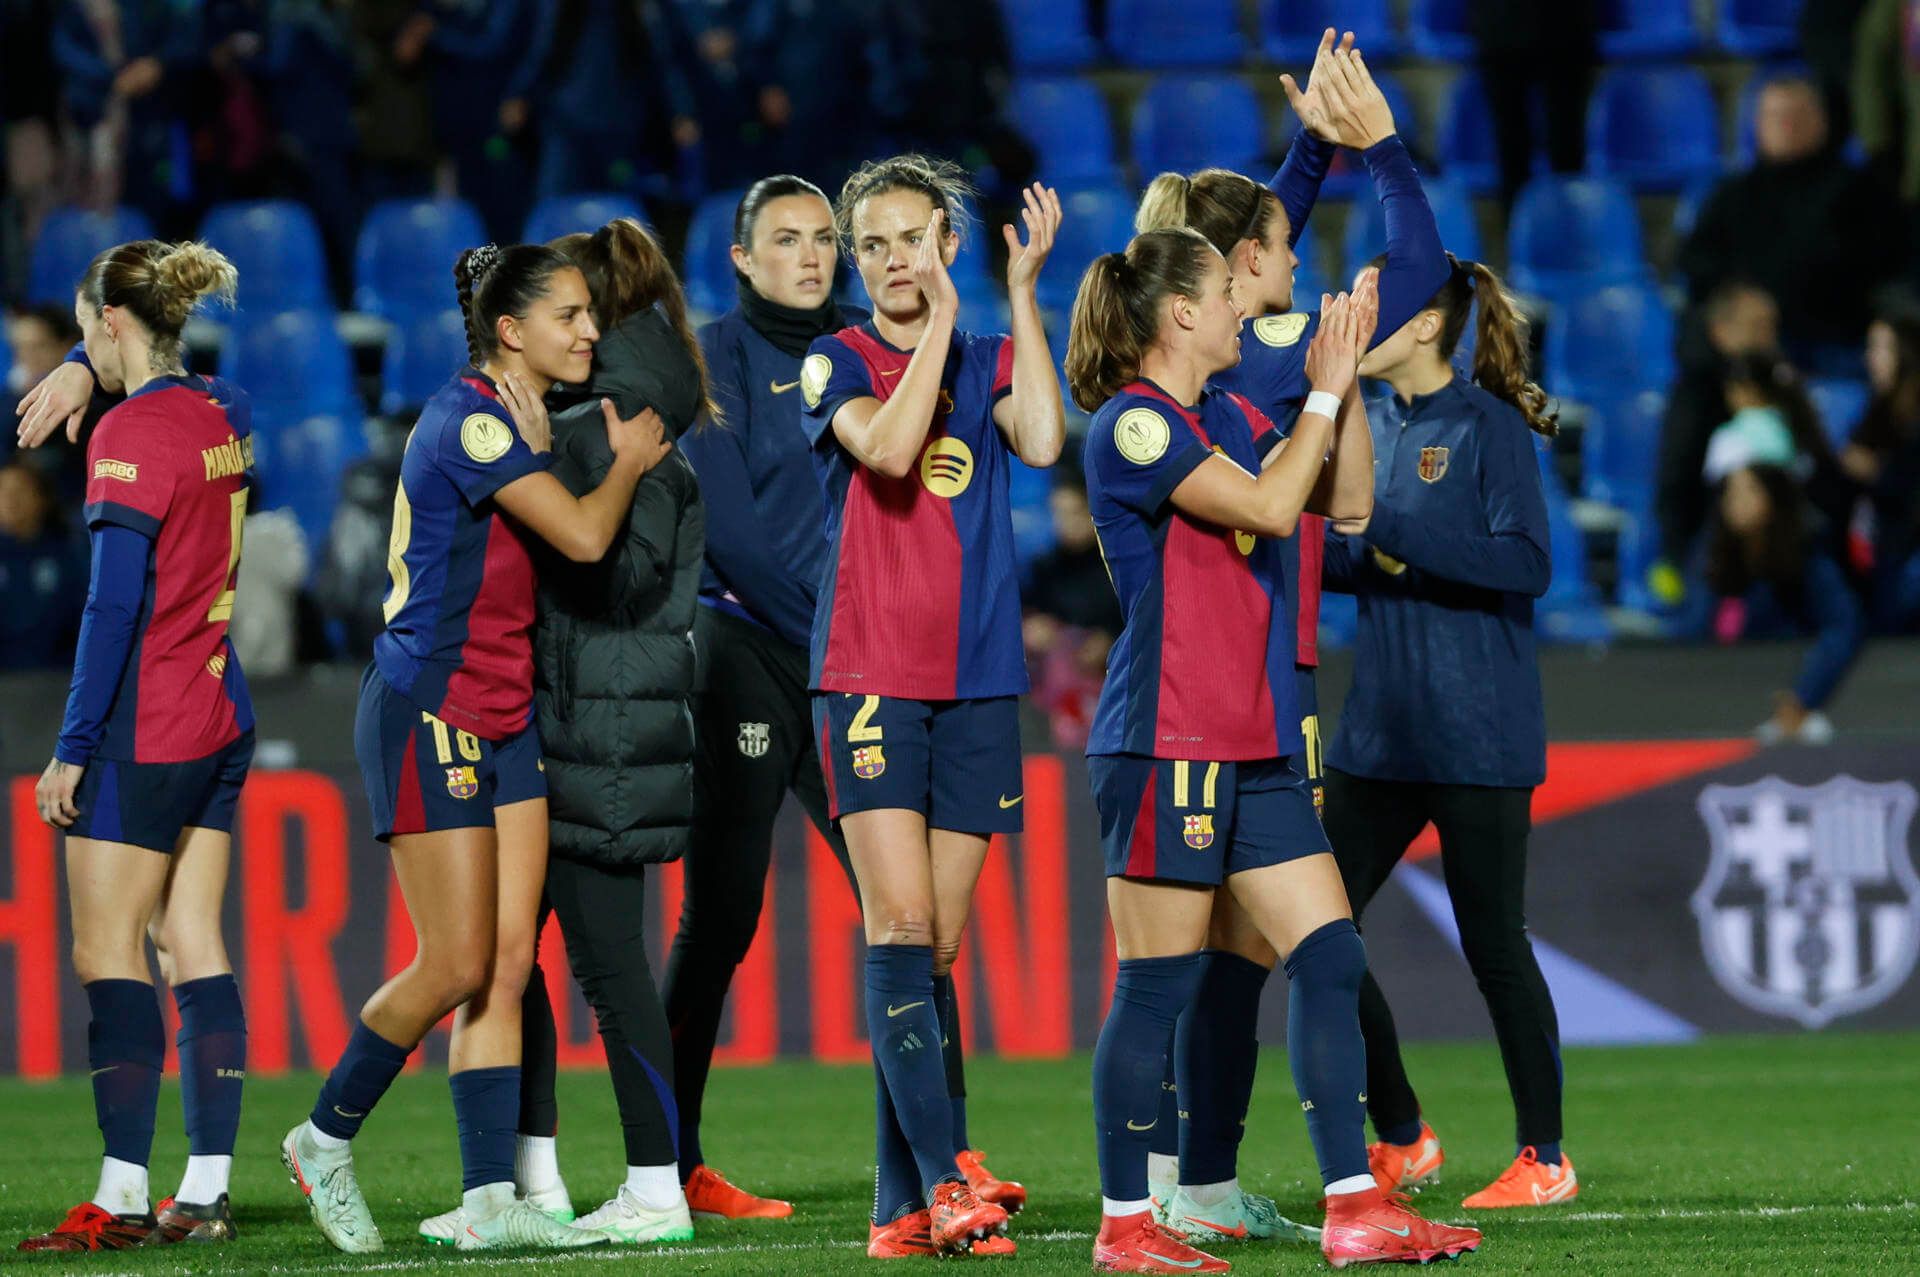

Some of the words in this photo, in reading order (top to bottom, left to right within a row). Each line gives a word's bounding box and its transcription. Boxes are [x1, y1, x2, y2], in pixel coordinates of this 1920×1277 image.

[95, 463, 138, 479] BIMBO
[845, 692, 883, 742] 2
[1301, 714, 1324, 779] 1
